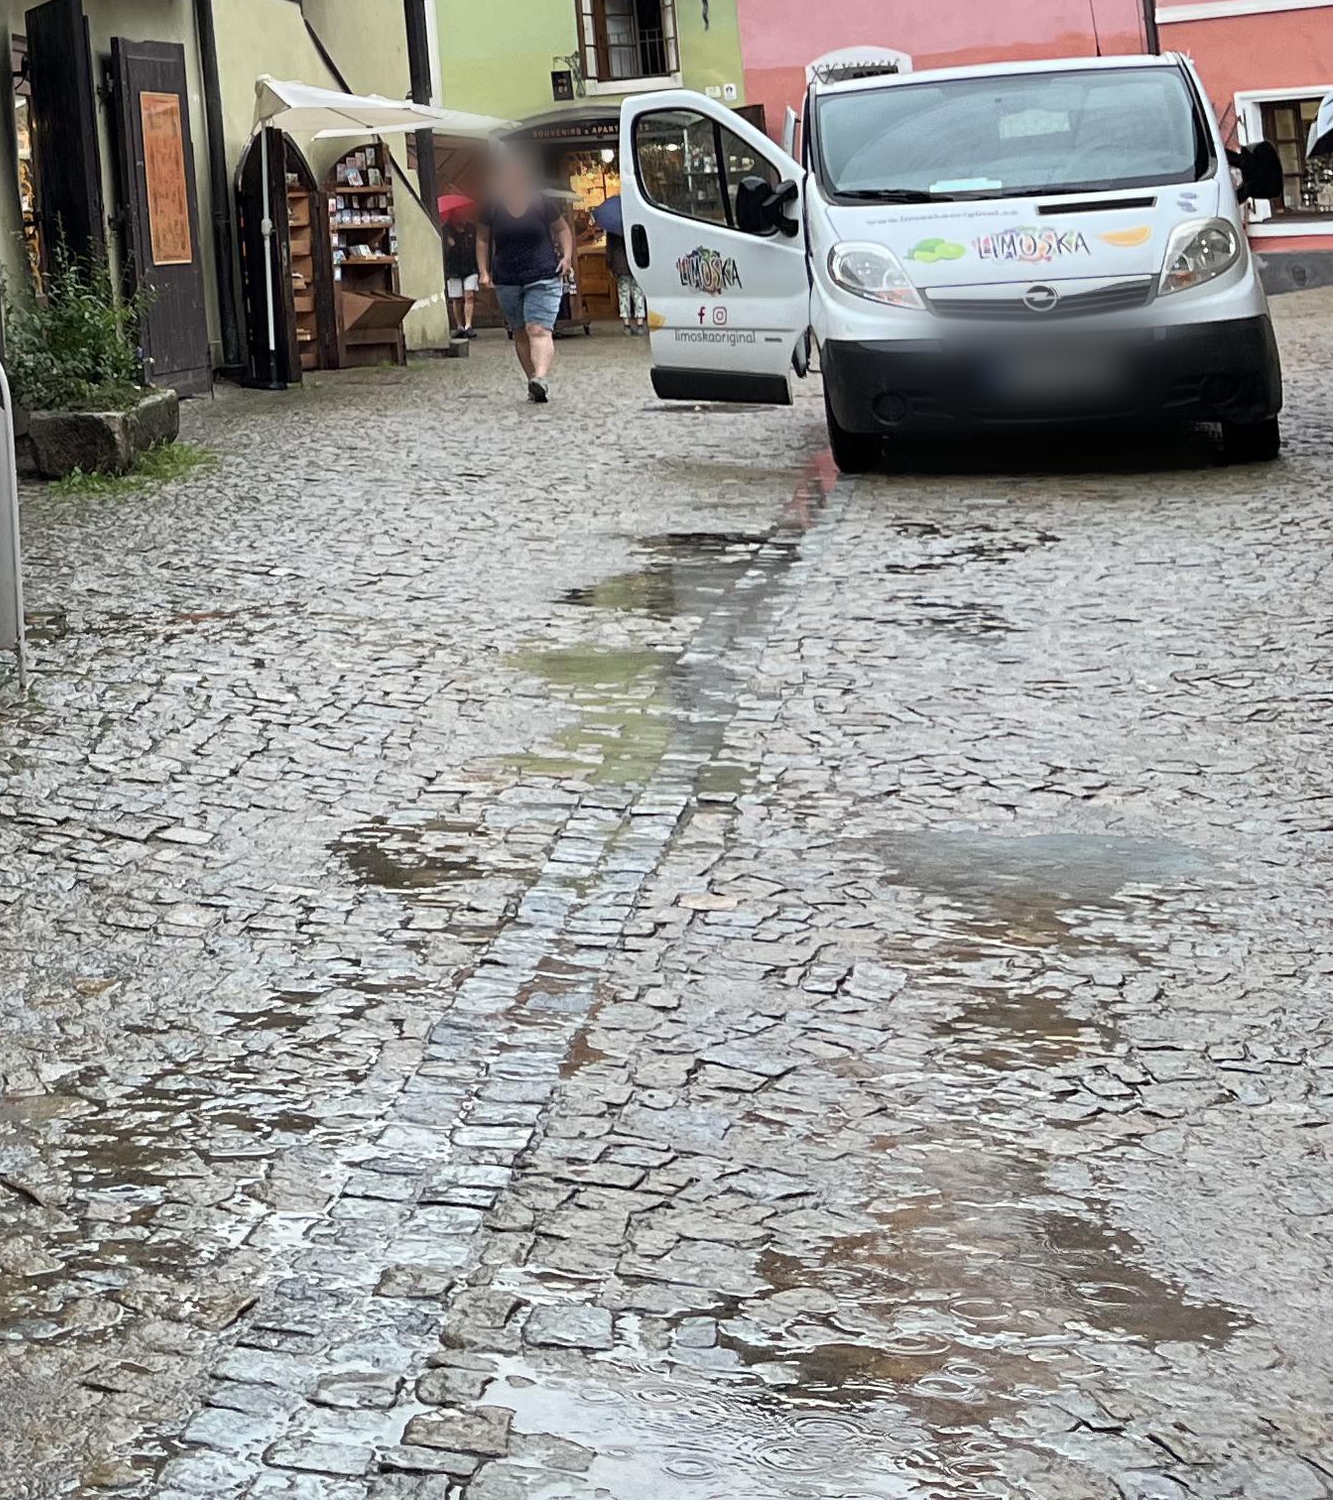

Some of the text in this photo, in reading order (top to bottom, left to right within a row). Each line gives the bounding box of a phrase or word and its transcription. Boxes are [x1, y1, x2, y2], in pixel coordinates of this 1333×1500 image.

[974, 231, 1092, 260] LIMOSKA
[677, 256, 743, 289] LIMOSKA
[674, 330, 756, 346] limoskaoriginal
